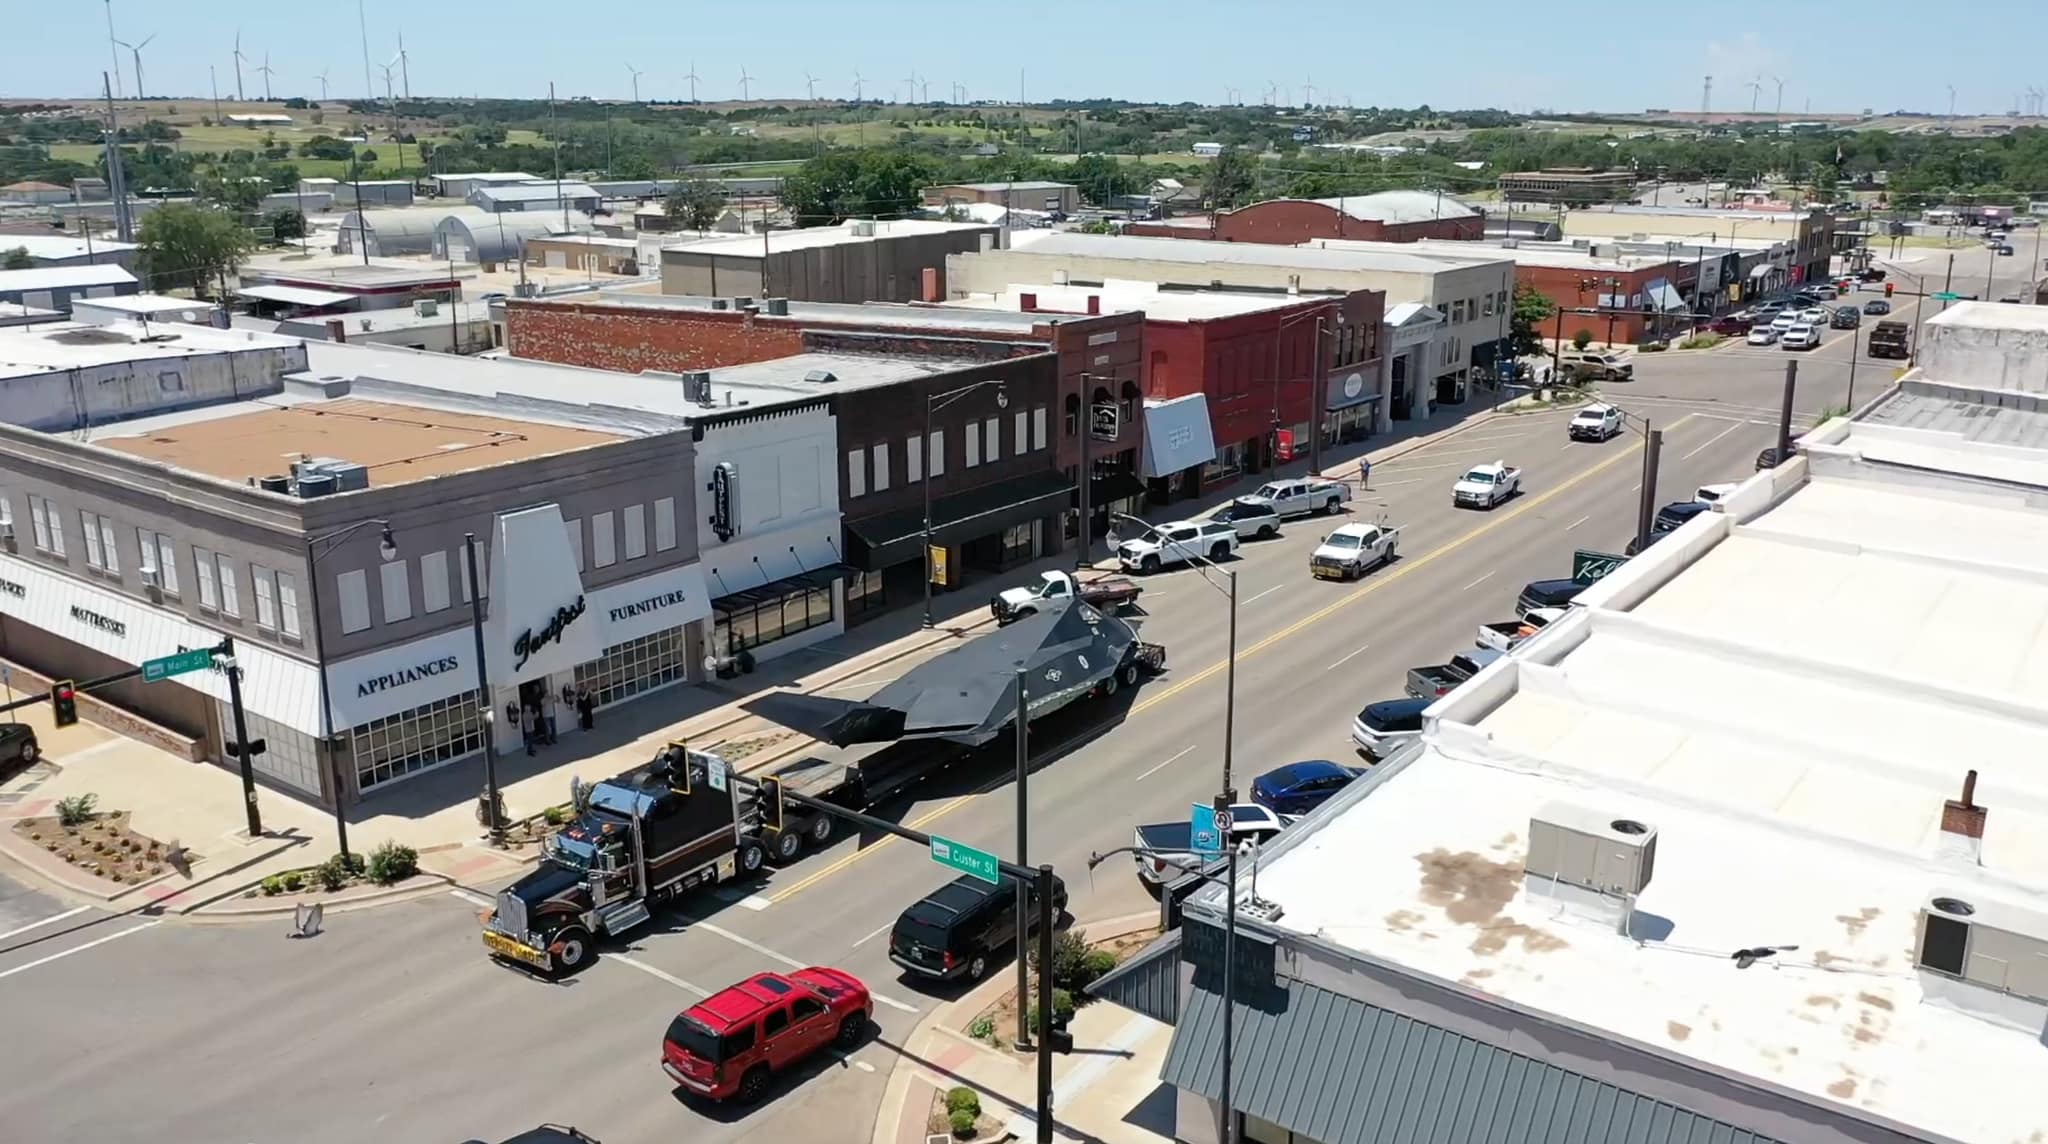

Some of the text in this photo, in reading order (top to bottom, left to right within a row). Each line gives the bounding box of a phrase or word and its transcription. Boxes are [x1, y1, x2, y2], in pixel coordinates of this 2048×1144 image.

[610, 590, 685, 622] FURNITURE
[167, 659, 189, 672] Main
[193, 654, 204, 666] St
[357, 656, 458, 698] APPLIANCES
[952, 849, 981, 870] Custer
